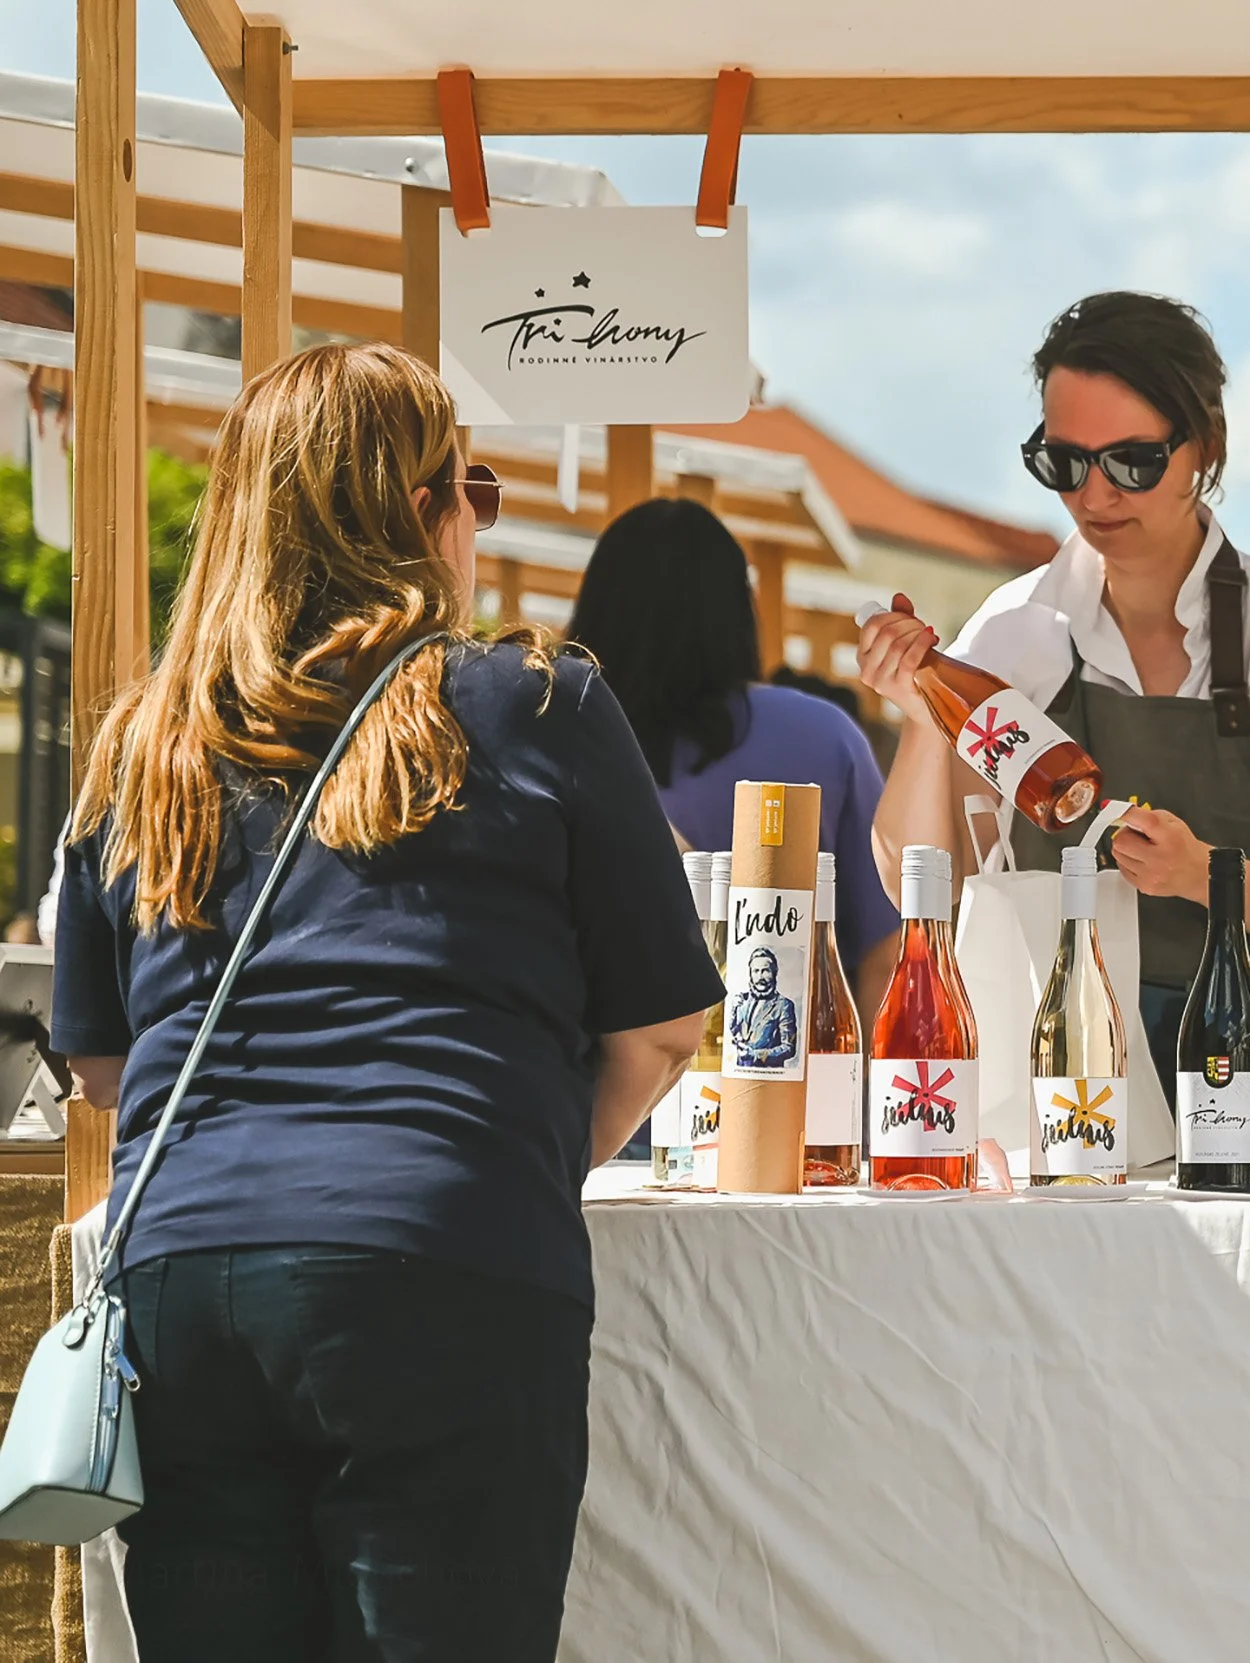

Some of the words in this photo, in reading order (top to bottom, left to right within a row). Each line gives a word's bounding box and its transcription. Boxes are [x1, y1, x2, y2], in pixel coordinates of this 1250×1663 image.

[481, 304, 595, 371] Tri
[571, 308, 707, 364] hony
[519, 355, 577, 364] RODINNÉ
[585, 355, 658, 364] VINÁRSTVO
